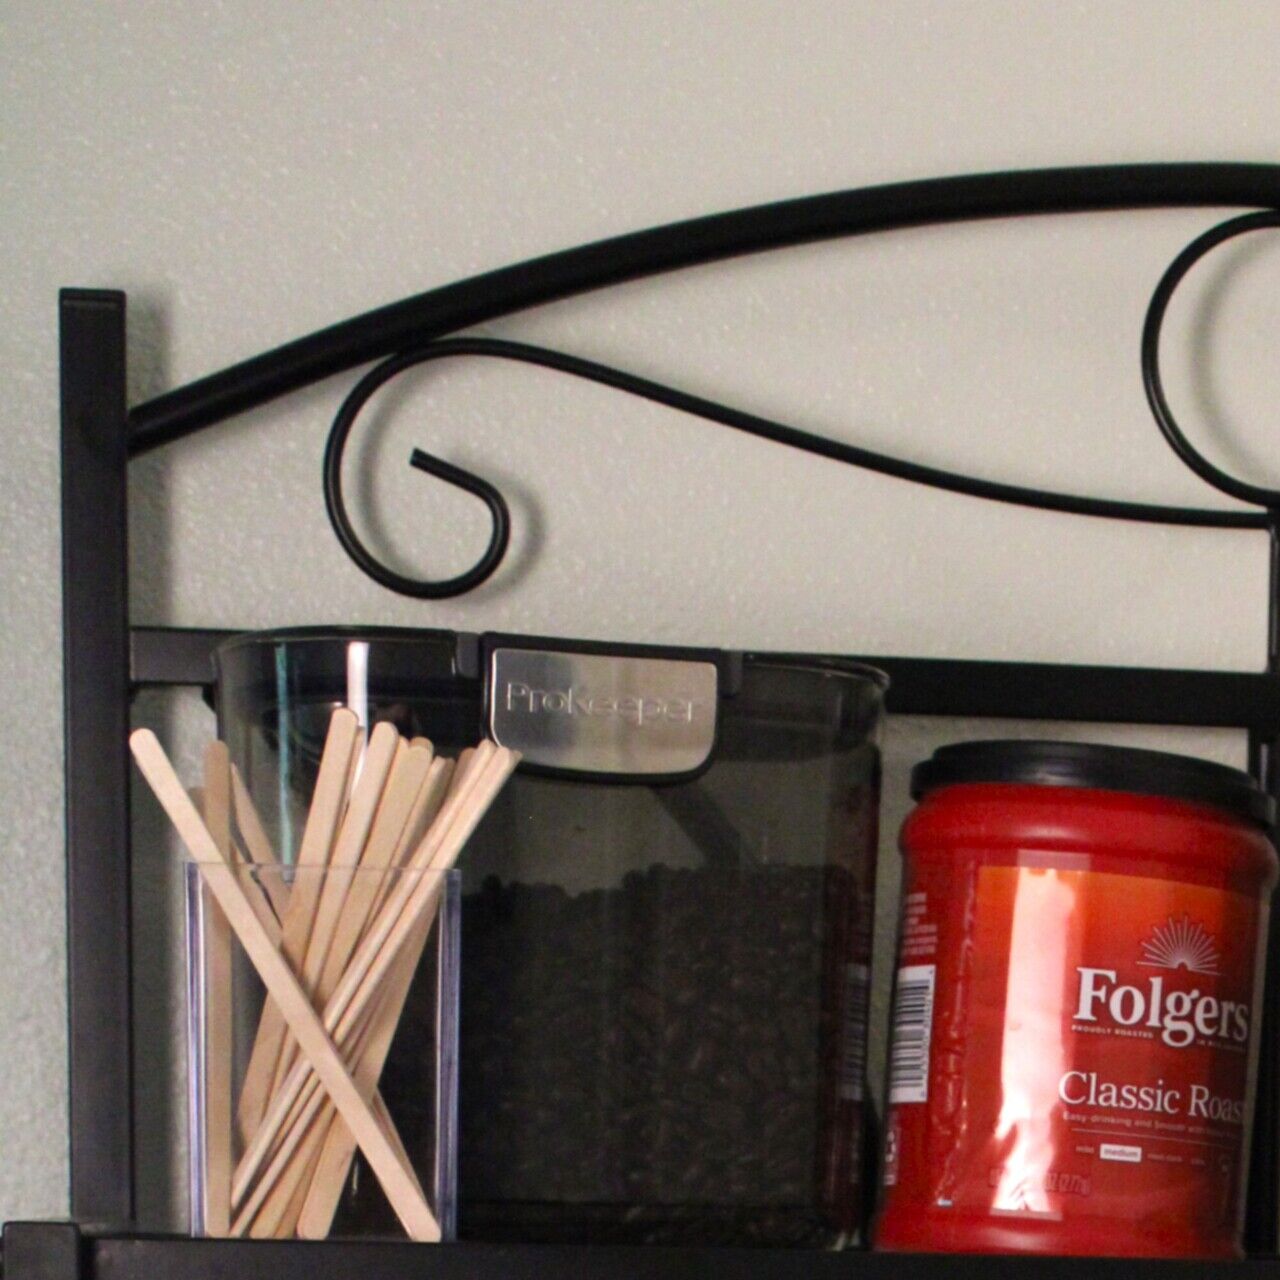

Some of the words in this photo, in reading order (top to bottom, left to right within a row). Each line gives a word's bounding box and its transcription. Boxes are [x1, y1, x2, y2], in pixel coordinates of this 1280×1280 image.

[1073, 966, 1248, 1047] Folgers
[1058, 1070, 1181, 1114] Classic
[1188, 1084, 1244, 1124] Roas
